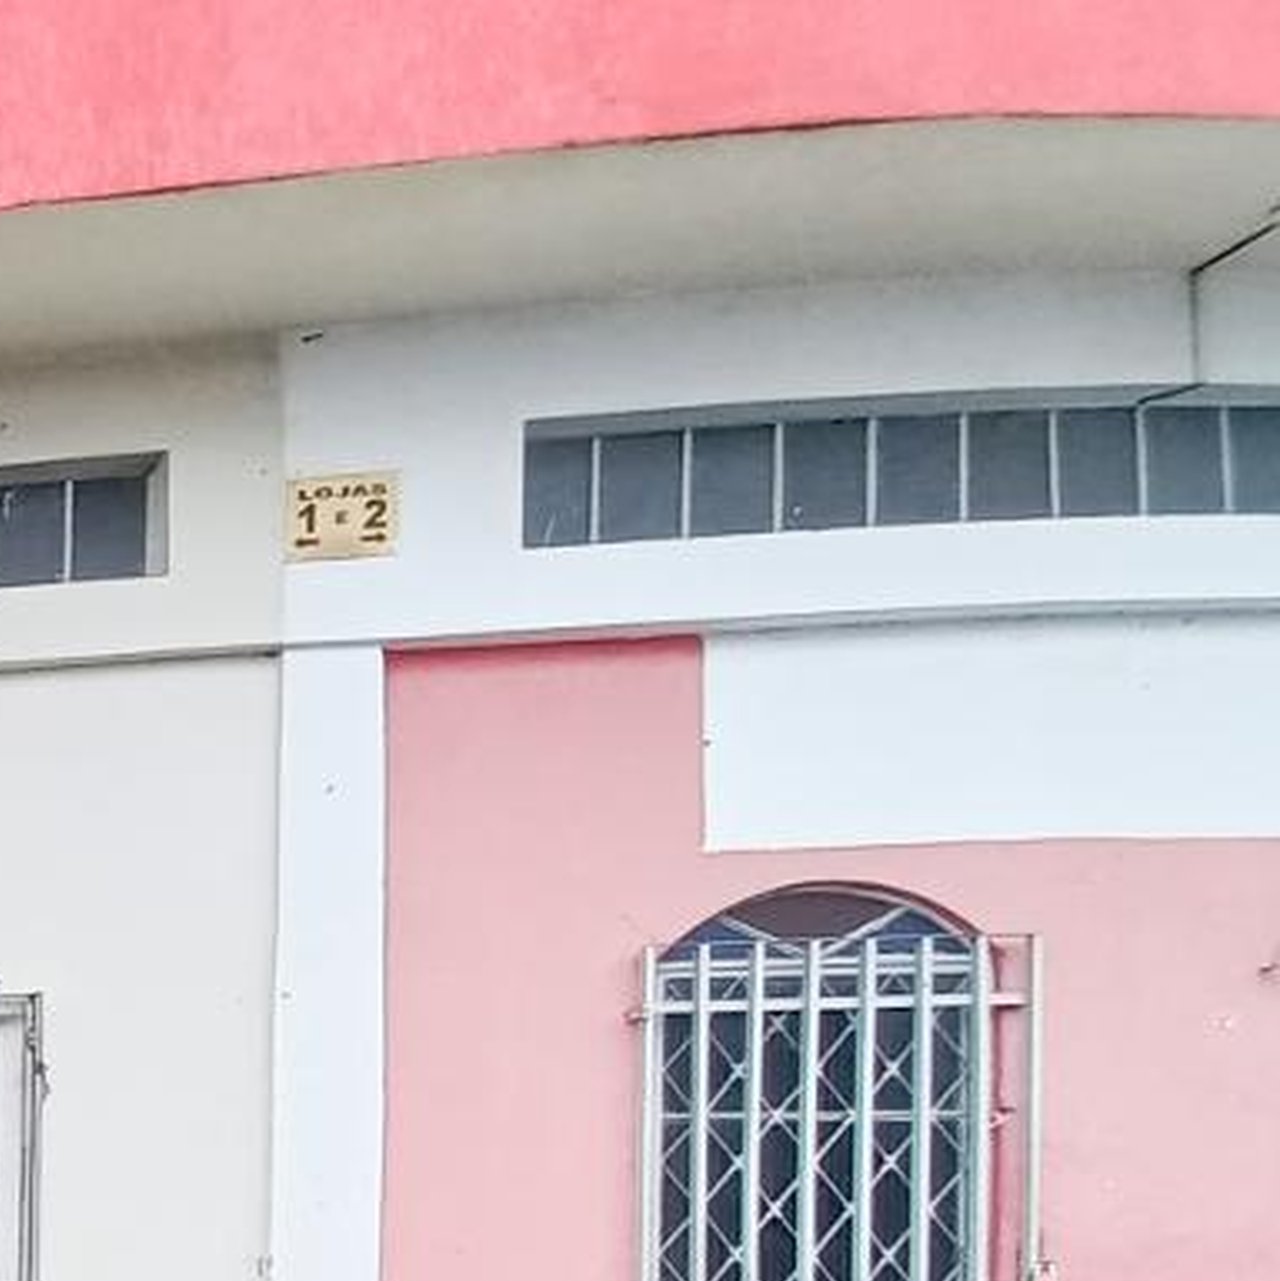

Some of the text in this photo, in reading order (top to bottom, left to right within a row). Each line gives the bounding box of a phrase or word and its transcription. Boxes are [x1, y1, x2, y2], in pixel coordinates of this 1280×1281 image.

[297, 483, 387, 501] LOJAS
[298, 503, 316, 533] 1
[362, 500, 387, 529] 2
